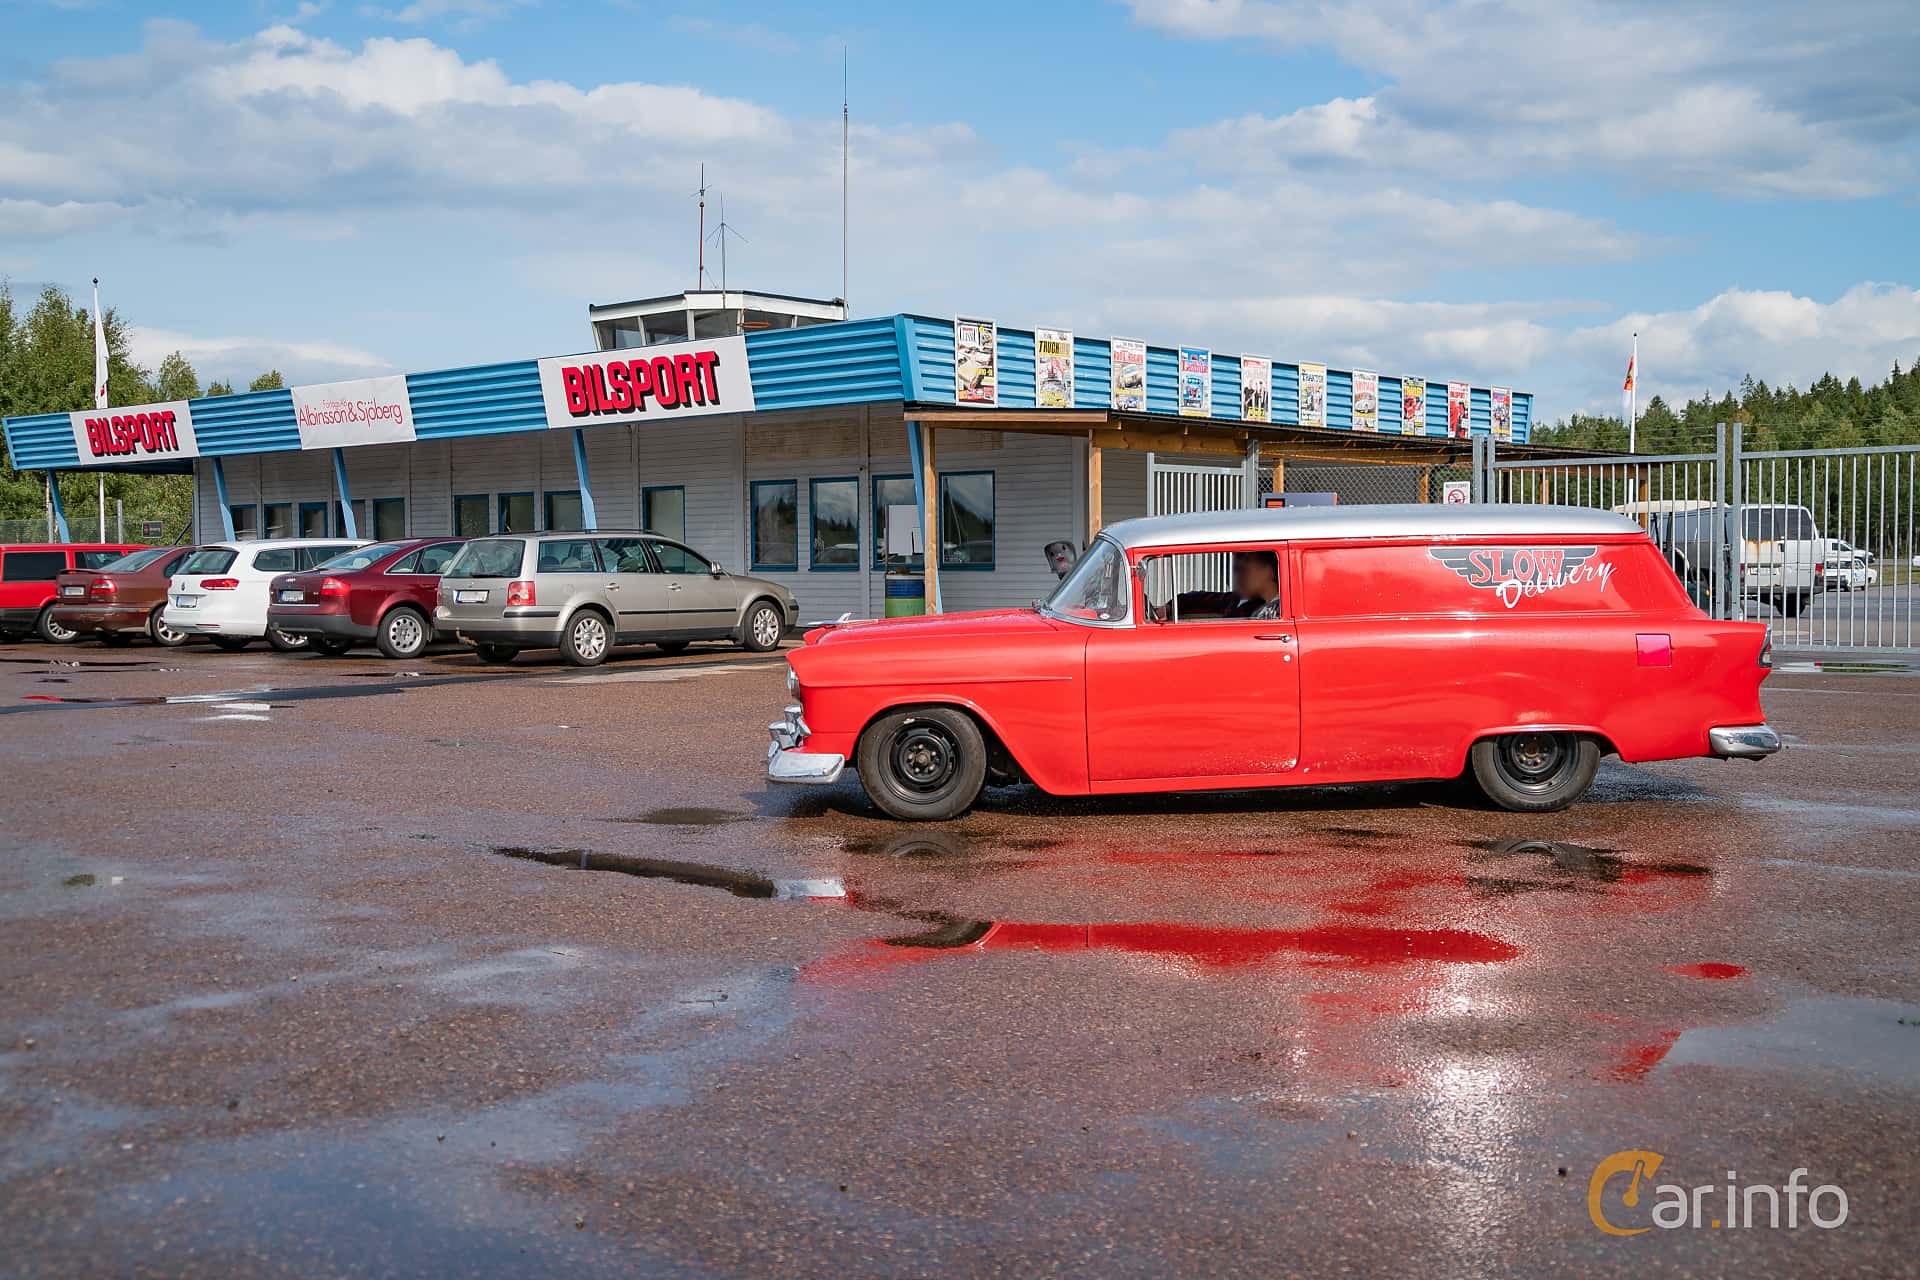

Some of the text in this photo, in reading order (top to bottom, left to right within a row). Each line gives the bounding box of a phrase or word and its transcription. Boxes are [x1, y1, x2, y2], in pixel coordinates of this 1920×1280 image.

[562, 351, 720, 417] BILSPORT
[85, 410, 179, 457] BILSPORT
[1469, 549, 1565, 584] SLOW
[1496, 562, 1617, 608] Delivery
